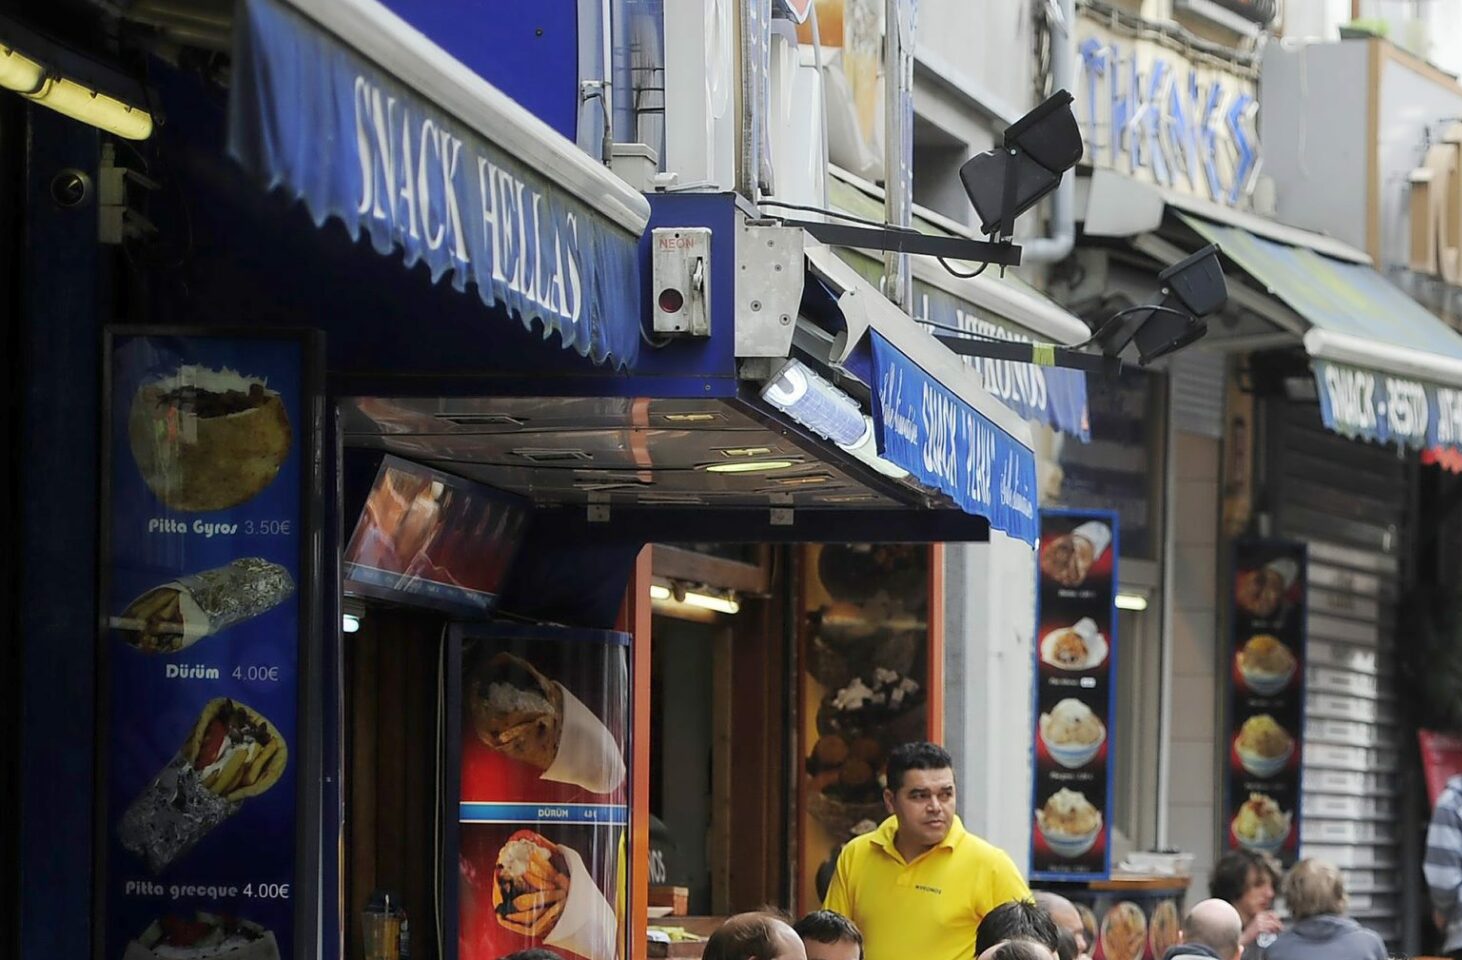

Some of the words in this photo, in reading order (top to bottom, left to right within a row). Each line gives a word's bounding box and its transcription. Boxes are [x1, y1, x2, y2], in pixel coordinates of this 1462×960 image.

[354, 75, 470, 263] SNACK
[478, 156, 582, 324] HELLAS
[659, 238, 694, 249] NEON
[922, 381, 957, 490] SNACK
[148, 518, 187, 534] Pitta
[193, 519, 238, 538] Gyros
[244, 520, 291, 535] 3.50€
[166, 664, 220, 679] Dürüm
[232, 666, 279, 681] 4.00€
[125, 881, 164, 896] Pitta
[170, 884, 239, 900] grecque
[242, 883, 290, 899] 4.00€
